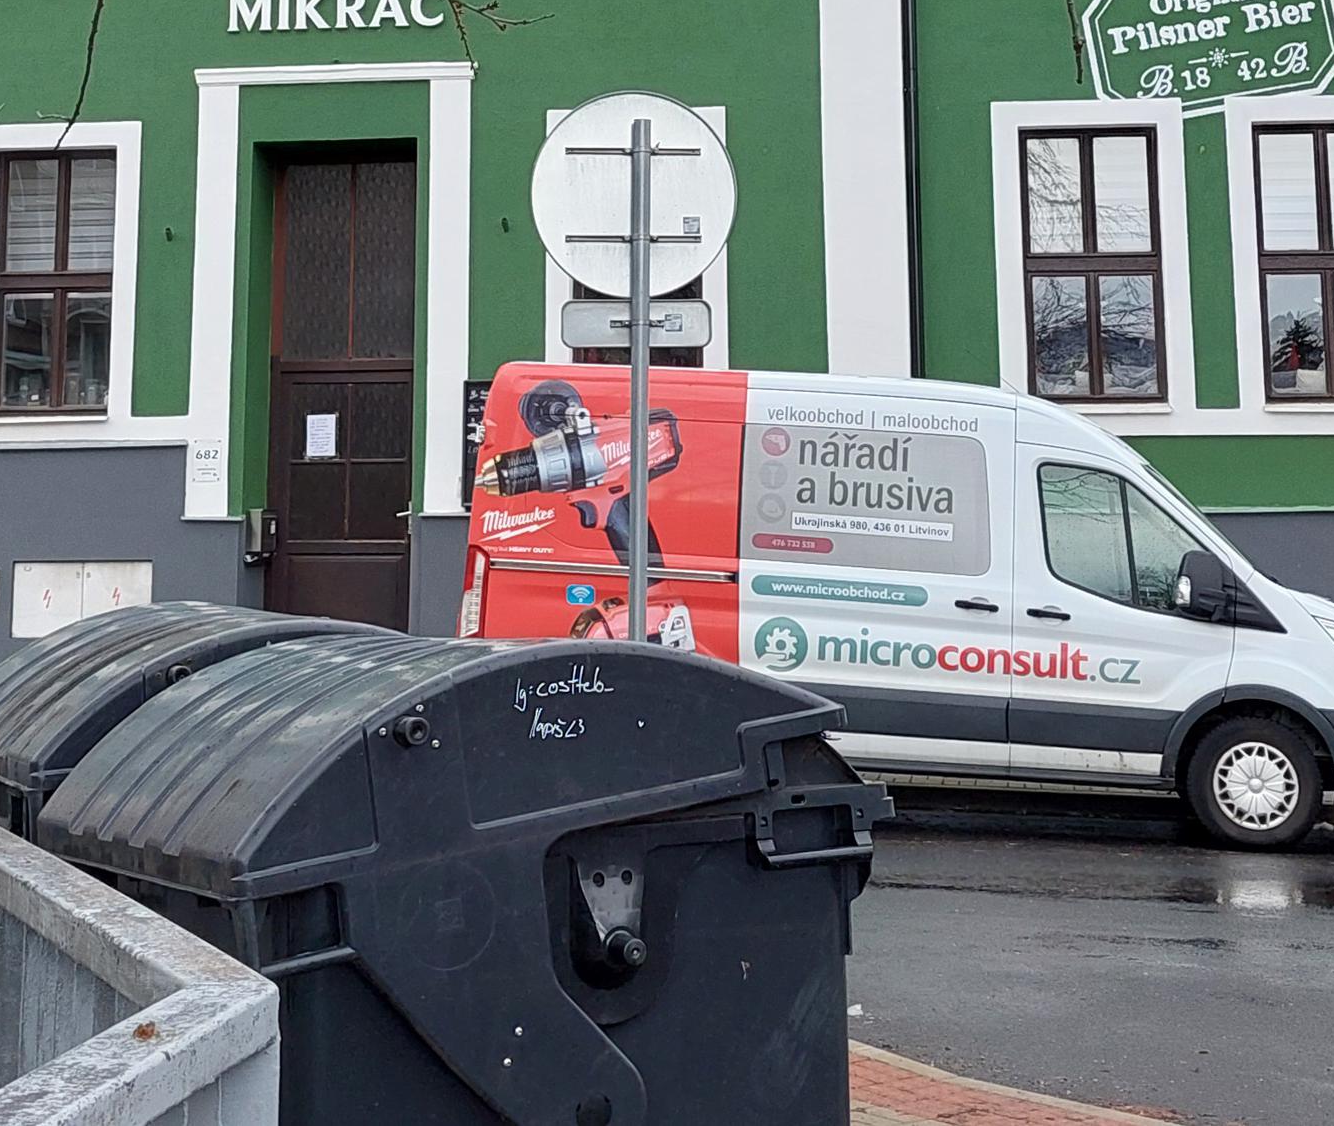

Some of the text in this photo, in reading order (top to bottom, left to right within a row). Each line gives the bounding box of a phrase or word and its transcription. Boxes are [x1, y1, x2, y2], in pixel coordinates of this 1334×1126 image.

[1107, 0, 1316, 55] Pilsner Bier
[1180, 66, 1211, 91] 18
[1236, 58, 1267, 82] 42
[767, 406, 864, 425] velkoobchod
[882, 412, 978, 433] maloobchod
[195, 449, 219, 460] 682
[799, 431, 913, 472] nářadí
[796, 471, 953, 515] a brusiva
[479, 506, 556, 534] Milwaukee
[794, 516, 847, 529] Ukrajinská
[873, 522, 891, 532] 436
[893, 524, 905, 533] 01
[771, 580, 906, 602] www.microobchod.cz
[817, 628, 1141, 686] microconsult.cz
